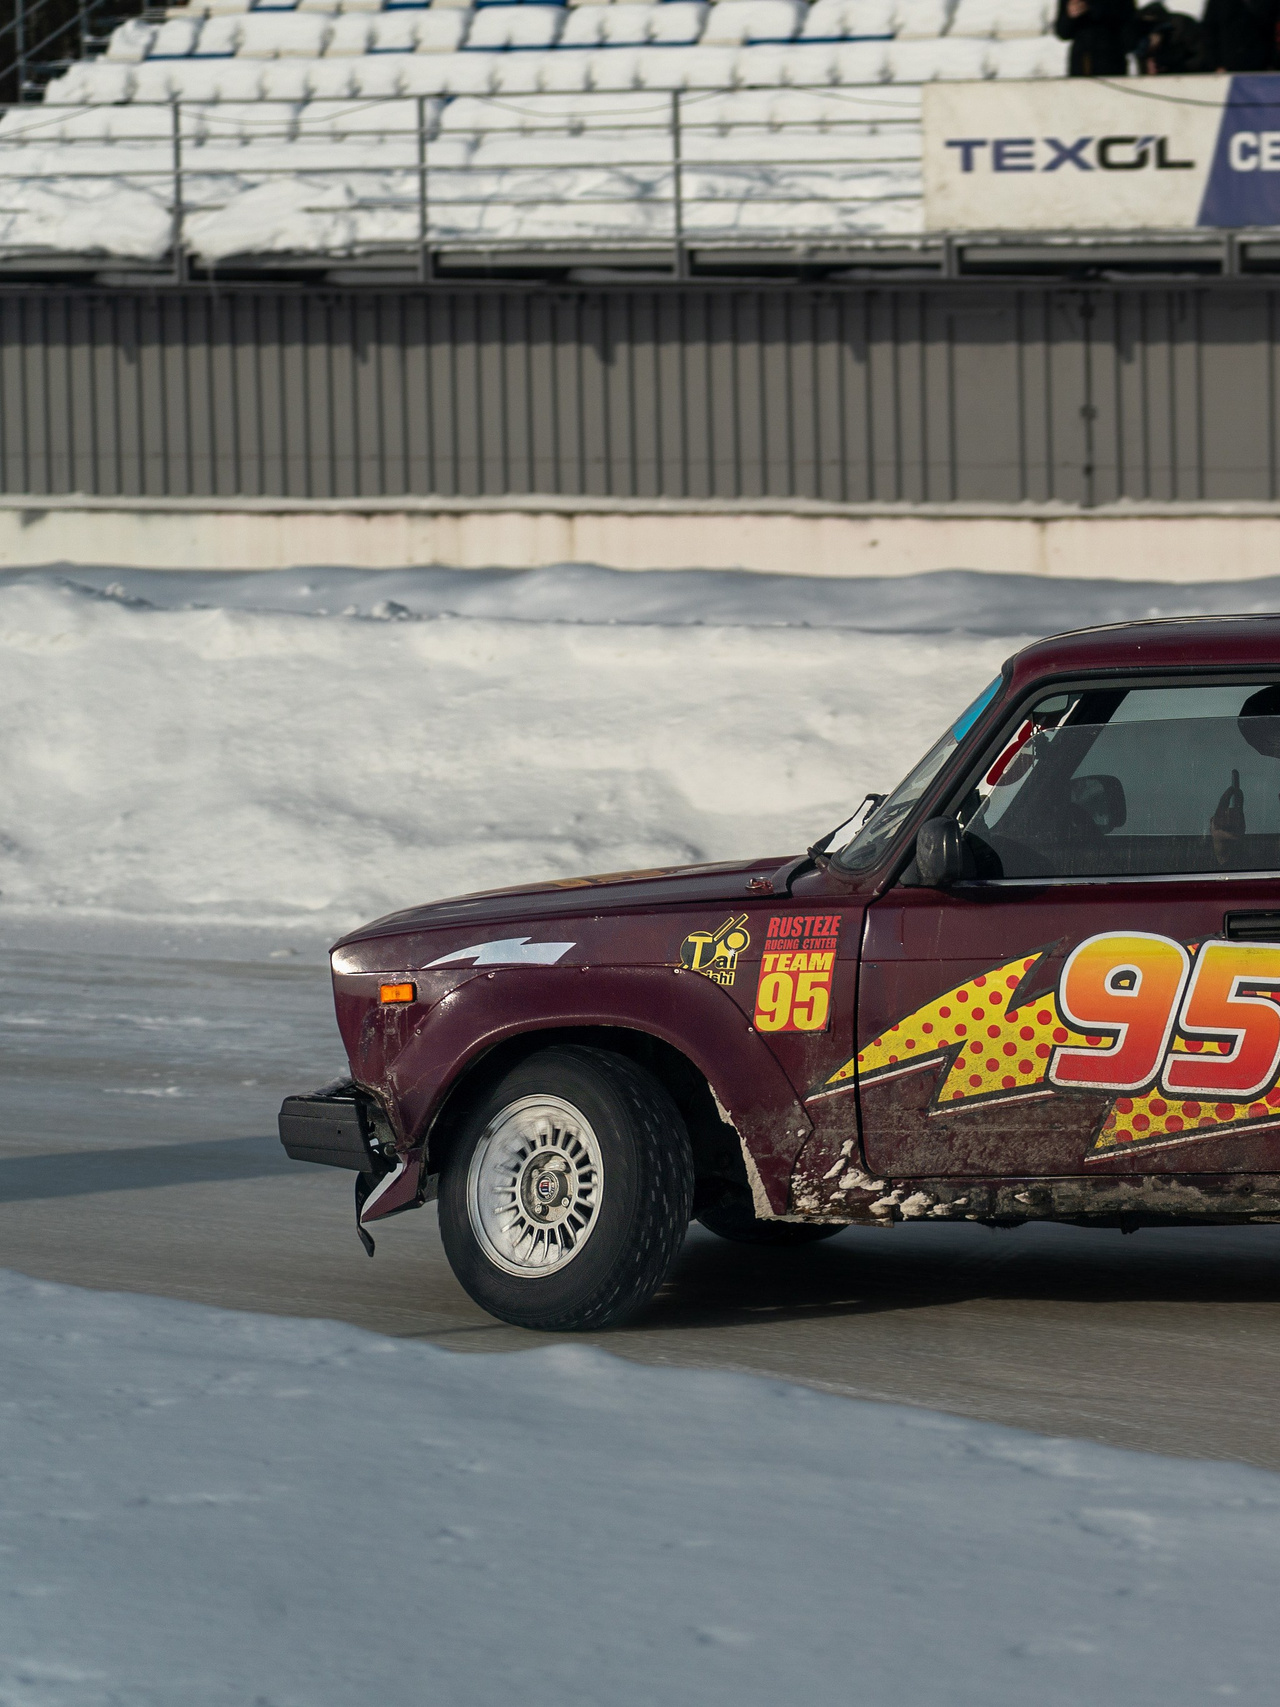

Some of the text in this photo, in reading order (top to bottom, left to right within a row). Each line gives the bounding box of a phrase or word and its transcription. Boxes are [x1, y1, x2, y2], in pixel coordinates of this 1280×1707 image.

[944, 134, 1196, 173] TEXOL
[767, 916, 841, 937] RUSTEZE
[762, 953, 834, 971] TEAM
[756, 972, 828, 1031] 95
